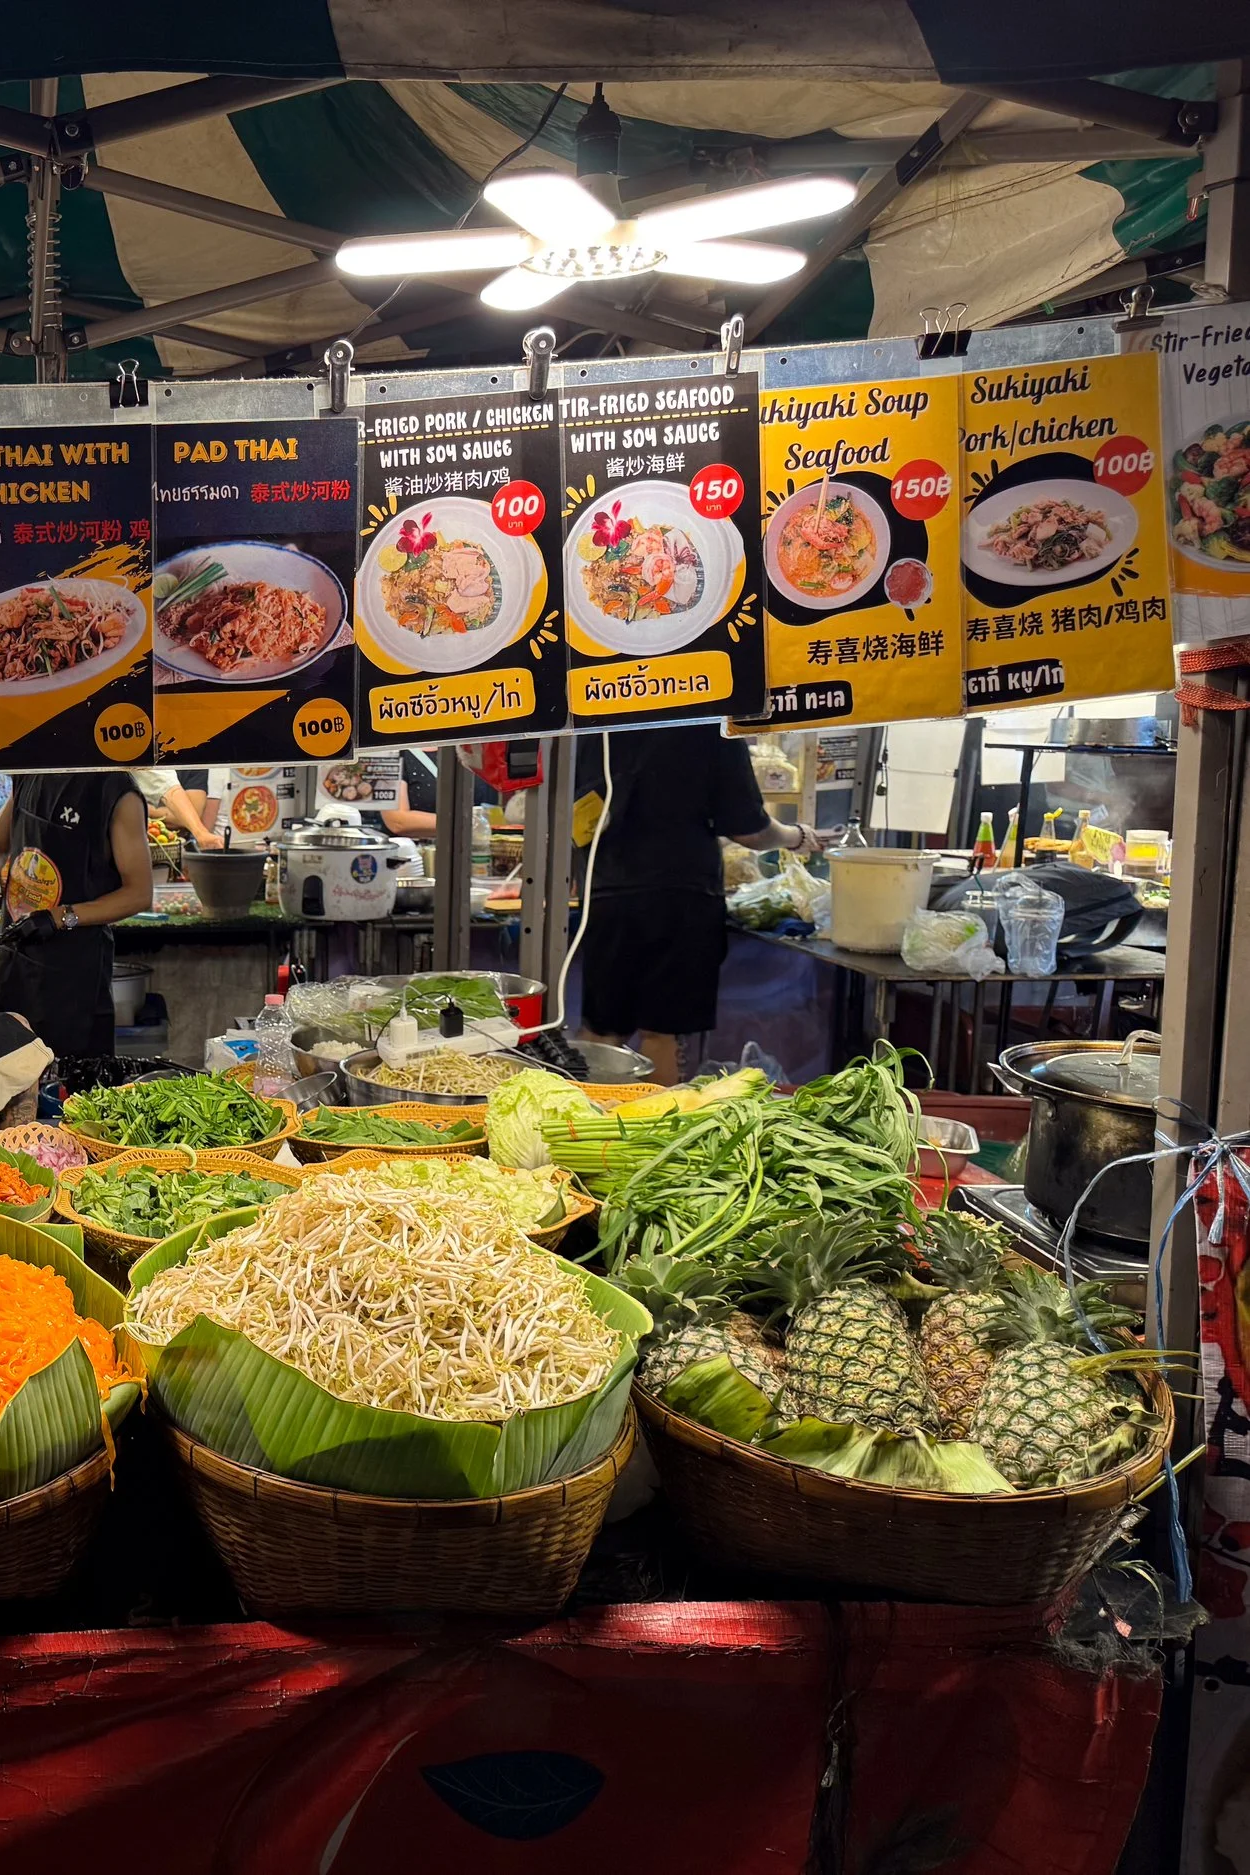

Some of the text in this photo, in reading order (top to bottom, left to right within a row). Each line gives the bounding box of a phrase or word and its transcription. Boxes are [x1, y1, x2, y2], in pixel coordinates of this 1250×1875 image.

[970, 365, 1092, 405] Sukiyaki
[558, 385, 736, 419] TIR-FRIED SEAFOOD
[864, 387, 930, 420] Soup
[425, 411, 468, 433] PORK
[485, 403, 554, 427] CHICKEN
[174, 438, 299, 464] PAD THAI
[570, 421, 721, 454] WITH SOY SAUCE
[59, 441, 130, 465] WITH
[379, 439, 513, 468] WITH SOY SAUCE
[606, 452, 686, 479] 酱炒海鲜
[784, 437, 891, 476] Seafood
[251, 479, 351, 503] 泰式炒河粉
[383, 466, 511, 498] 酱油炒猪肉/鸡
[692, 478, 739, 502] 150
[495, 494, 540, 518] 100
[13, 518, 151, 545] 泰式炒河粉 鸡
[966, 597, 1168, 644] 寿喜烧 猪肉/鸡肉
[807, 629, 945, 666] 寿喜烧海鲜
[805, 690, 846, 710] ทะเล
